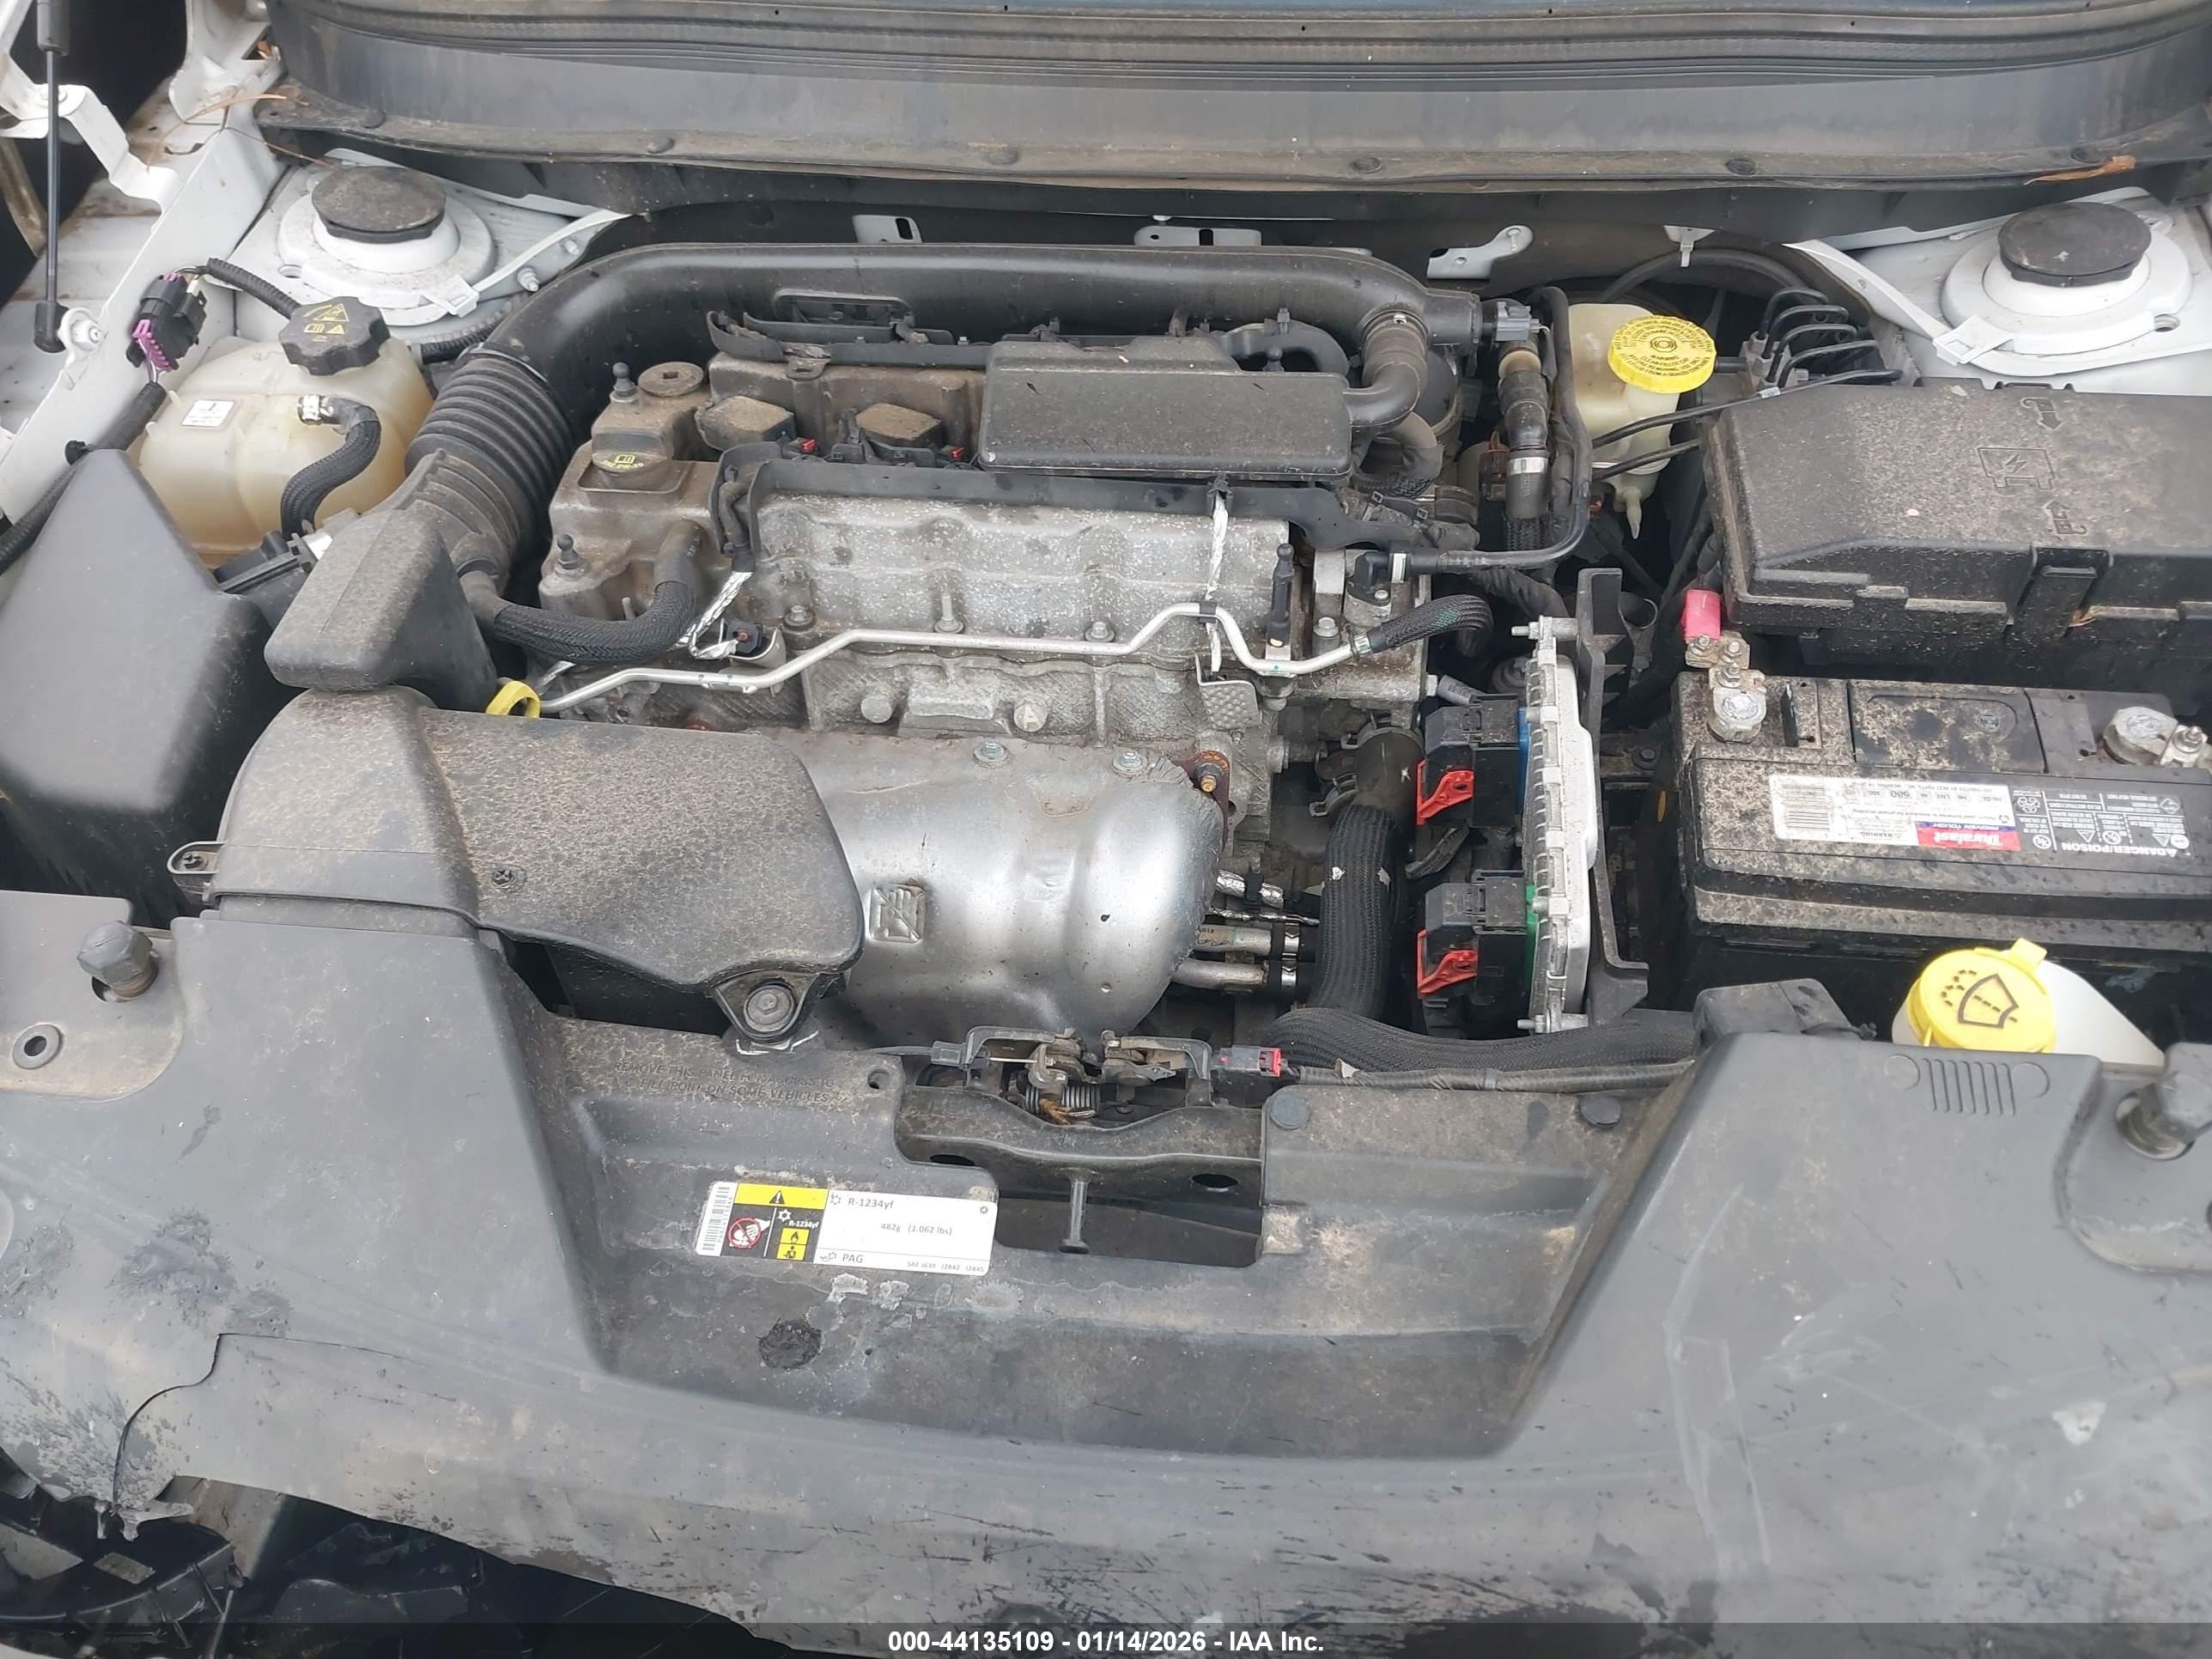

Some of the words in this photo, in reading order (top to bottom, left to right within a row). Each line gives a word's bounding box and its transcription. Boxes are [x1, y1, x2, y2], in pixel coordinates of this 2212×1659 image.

[1935, 832, 2002, 846] Duralast
[2061, 842, 2167, 856] DANGER/POISON
[613, 1062, 670, 1073] REMOVE
[670, 1066, 694, 1077] THIS
[699, 1069, 738, 1080] PANEL
[640, 1078, 665, 1090] FILL
[705, 1084, 726, 1094] ON
[730, 1085, 766, 1097] SOME
[848, 1197, 894, 1209] R-1234yf
[788, 1219, 820, 1230] R-1234yf
[880, 1223, 901, 1233] 482g
[908, 1224, 935, 1235] (1.062
[936, 1225, 953, 1237] lbs)
[842, 1253, 864, 1264] PAG
